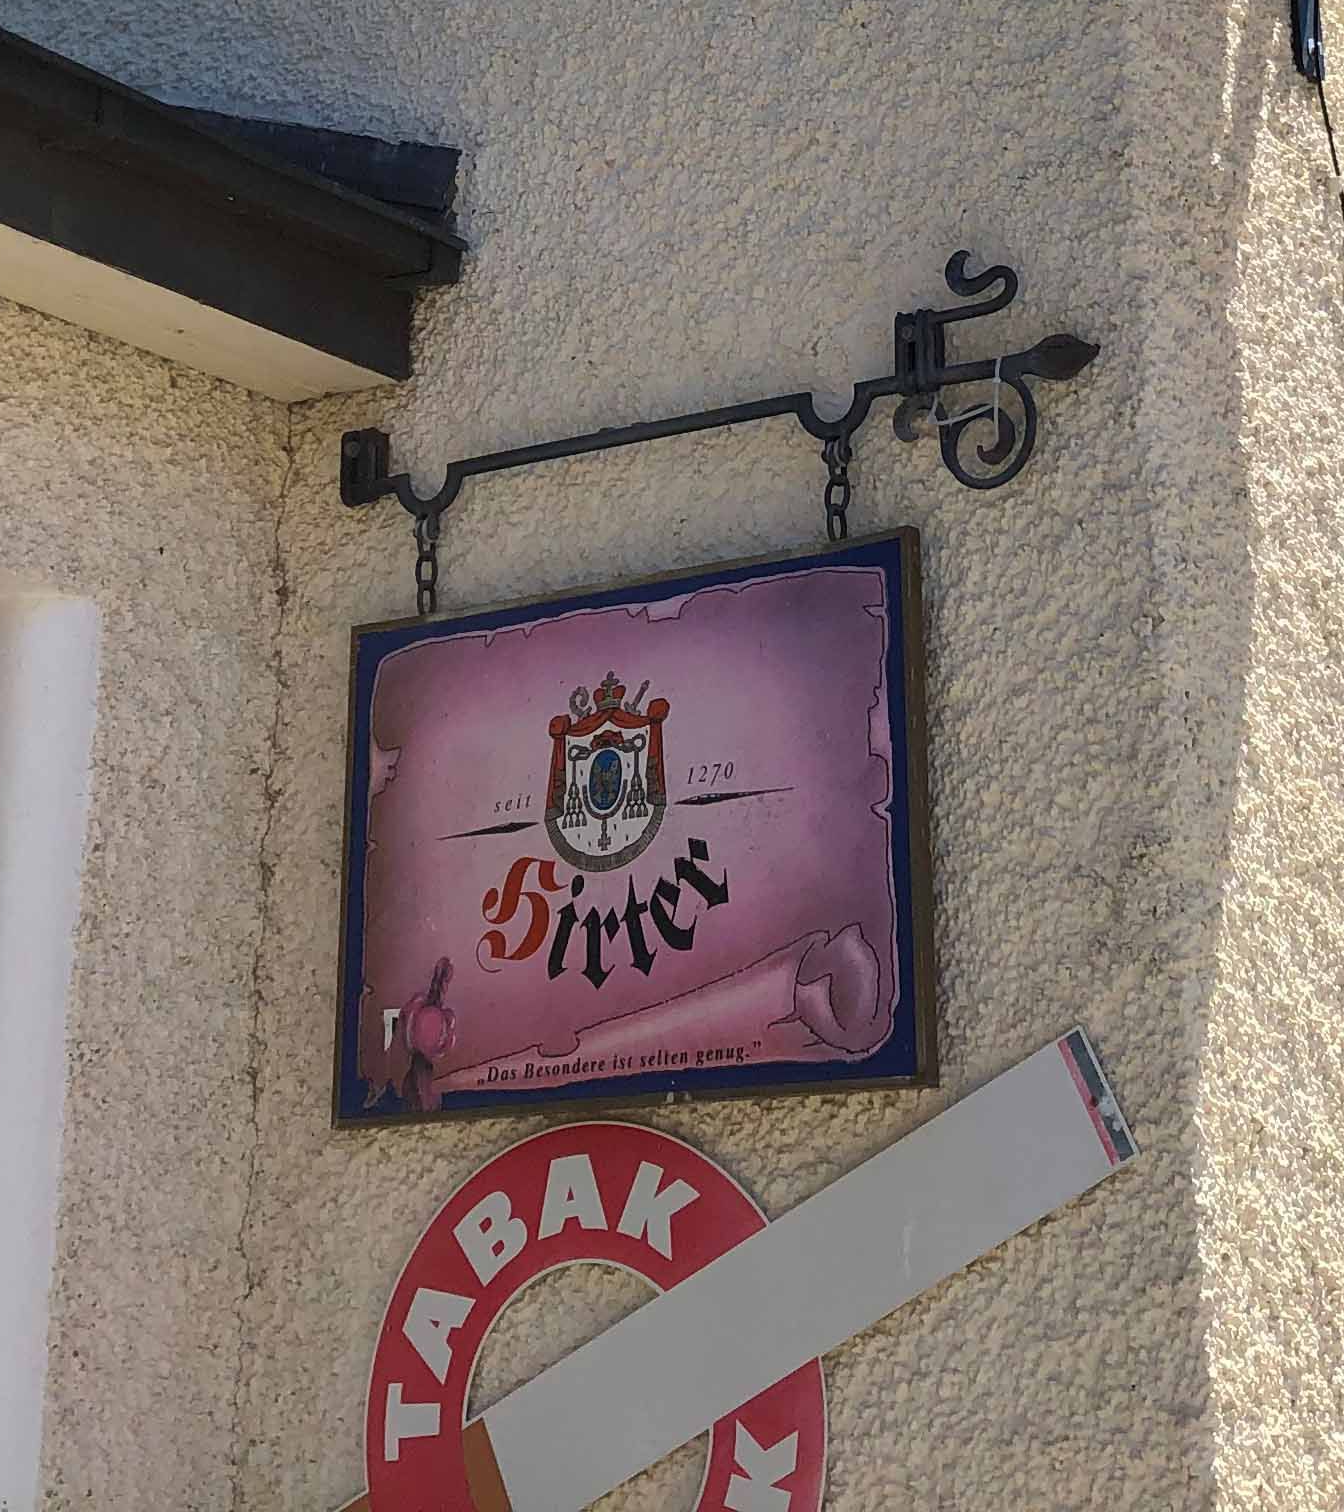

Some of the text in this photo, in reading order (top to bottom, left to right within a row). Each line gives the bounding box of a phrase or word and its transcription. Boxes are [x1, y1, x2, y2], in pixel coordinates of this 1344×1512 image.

[493, 760, 735, 814] seit 1270
[475, 837, 729, 990] Hirter
[523, 1060, 606, 1081] Besondere
[612, 1054, 633, 1071] ist
[639, 1048, 689, 1068] selten
[384, 1153, 700, 1462] TABAK
